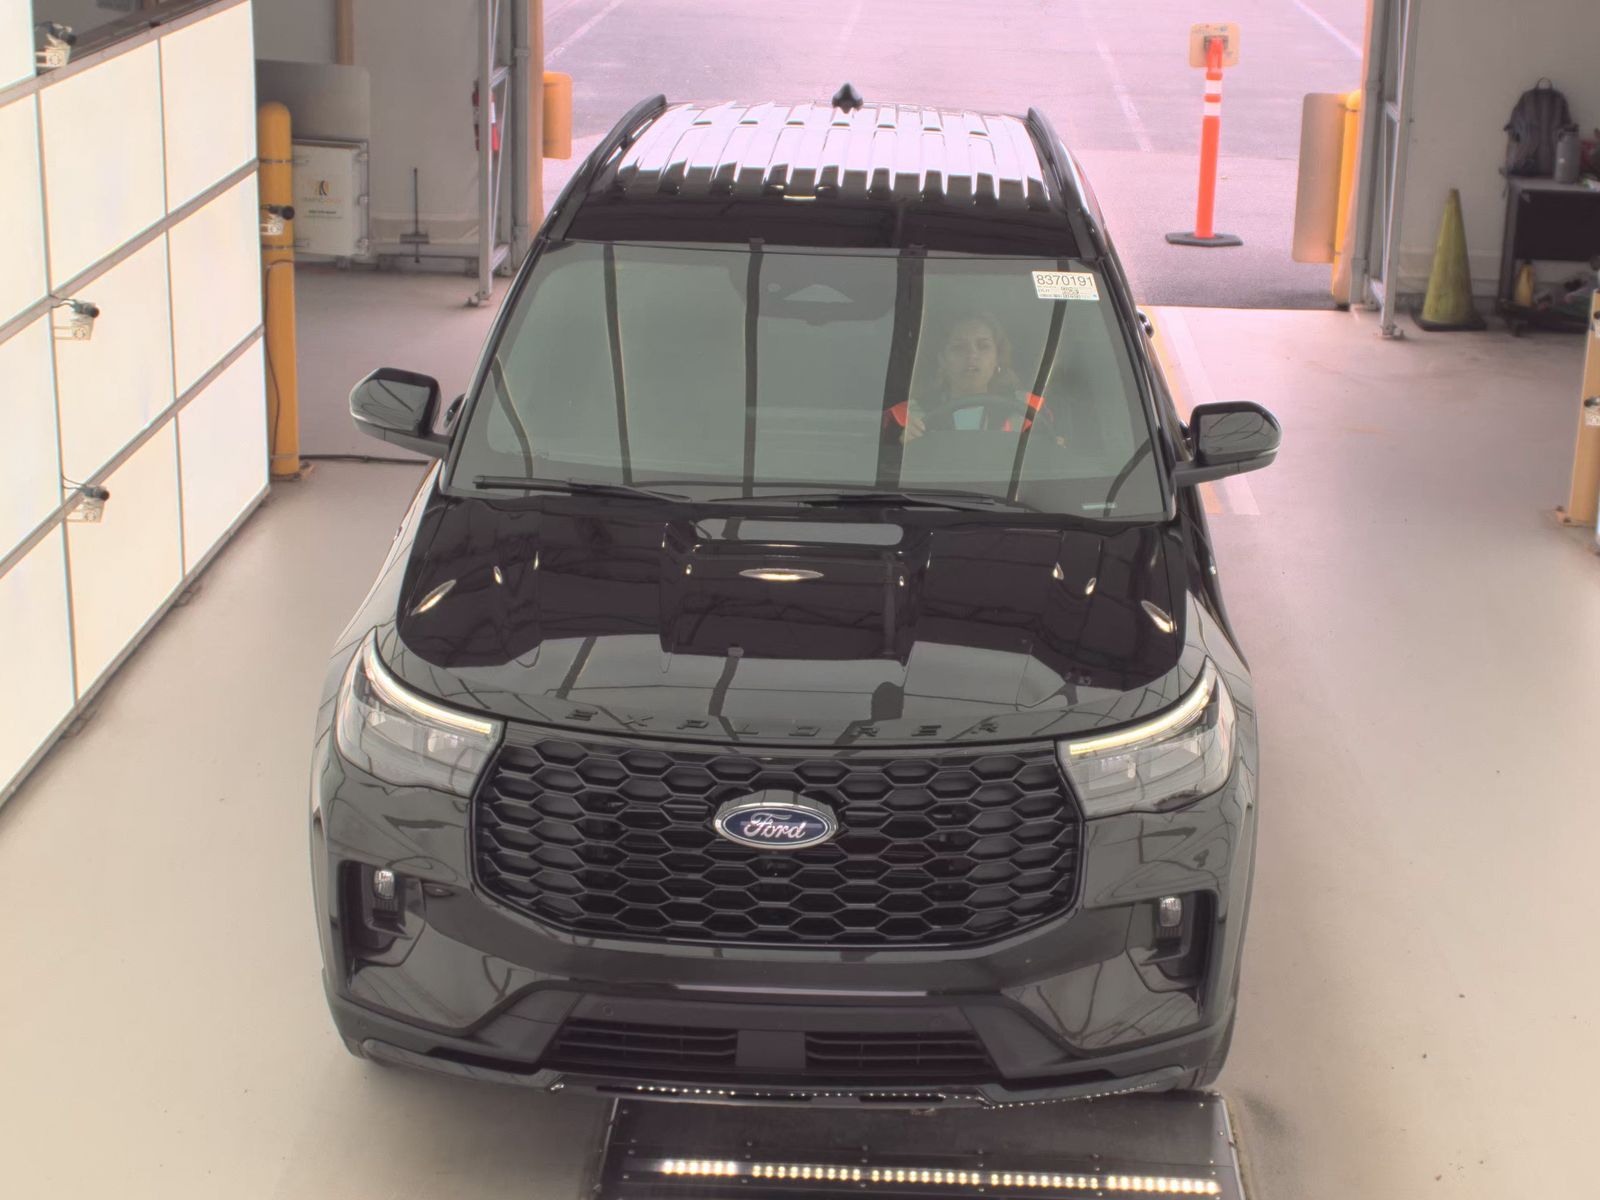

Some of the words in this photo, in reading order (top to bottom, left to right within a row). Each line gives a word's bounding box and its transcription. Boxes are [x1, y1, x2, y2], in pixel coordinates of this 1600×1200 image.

[1036, 274, 1093, 286] 8370191
[566, 709, 998, 737] EXPLORER
[743, 812, 807, 839] Ford
